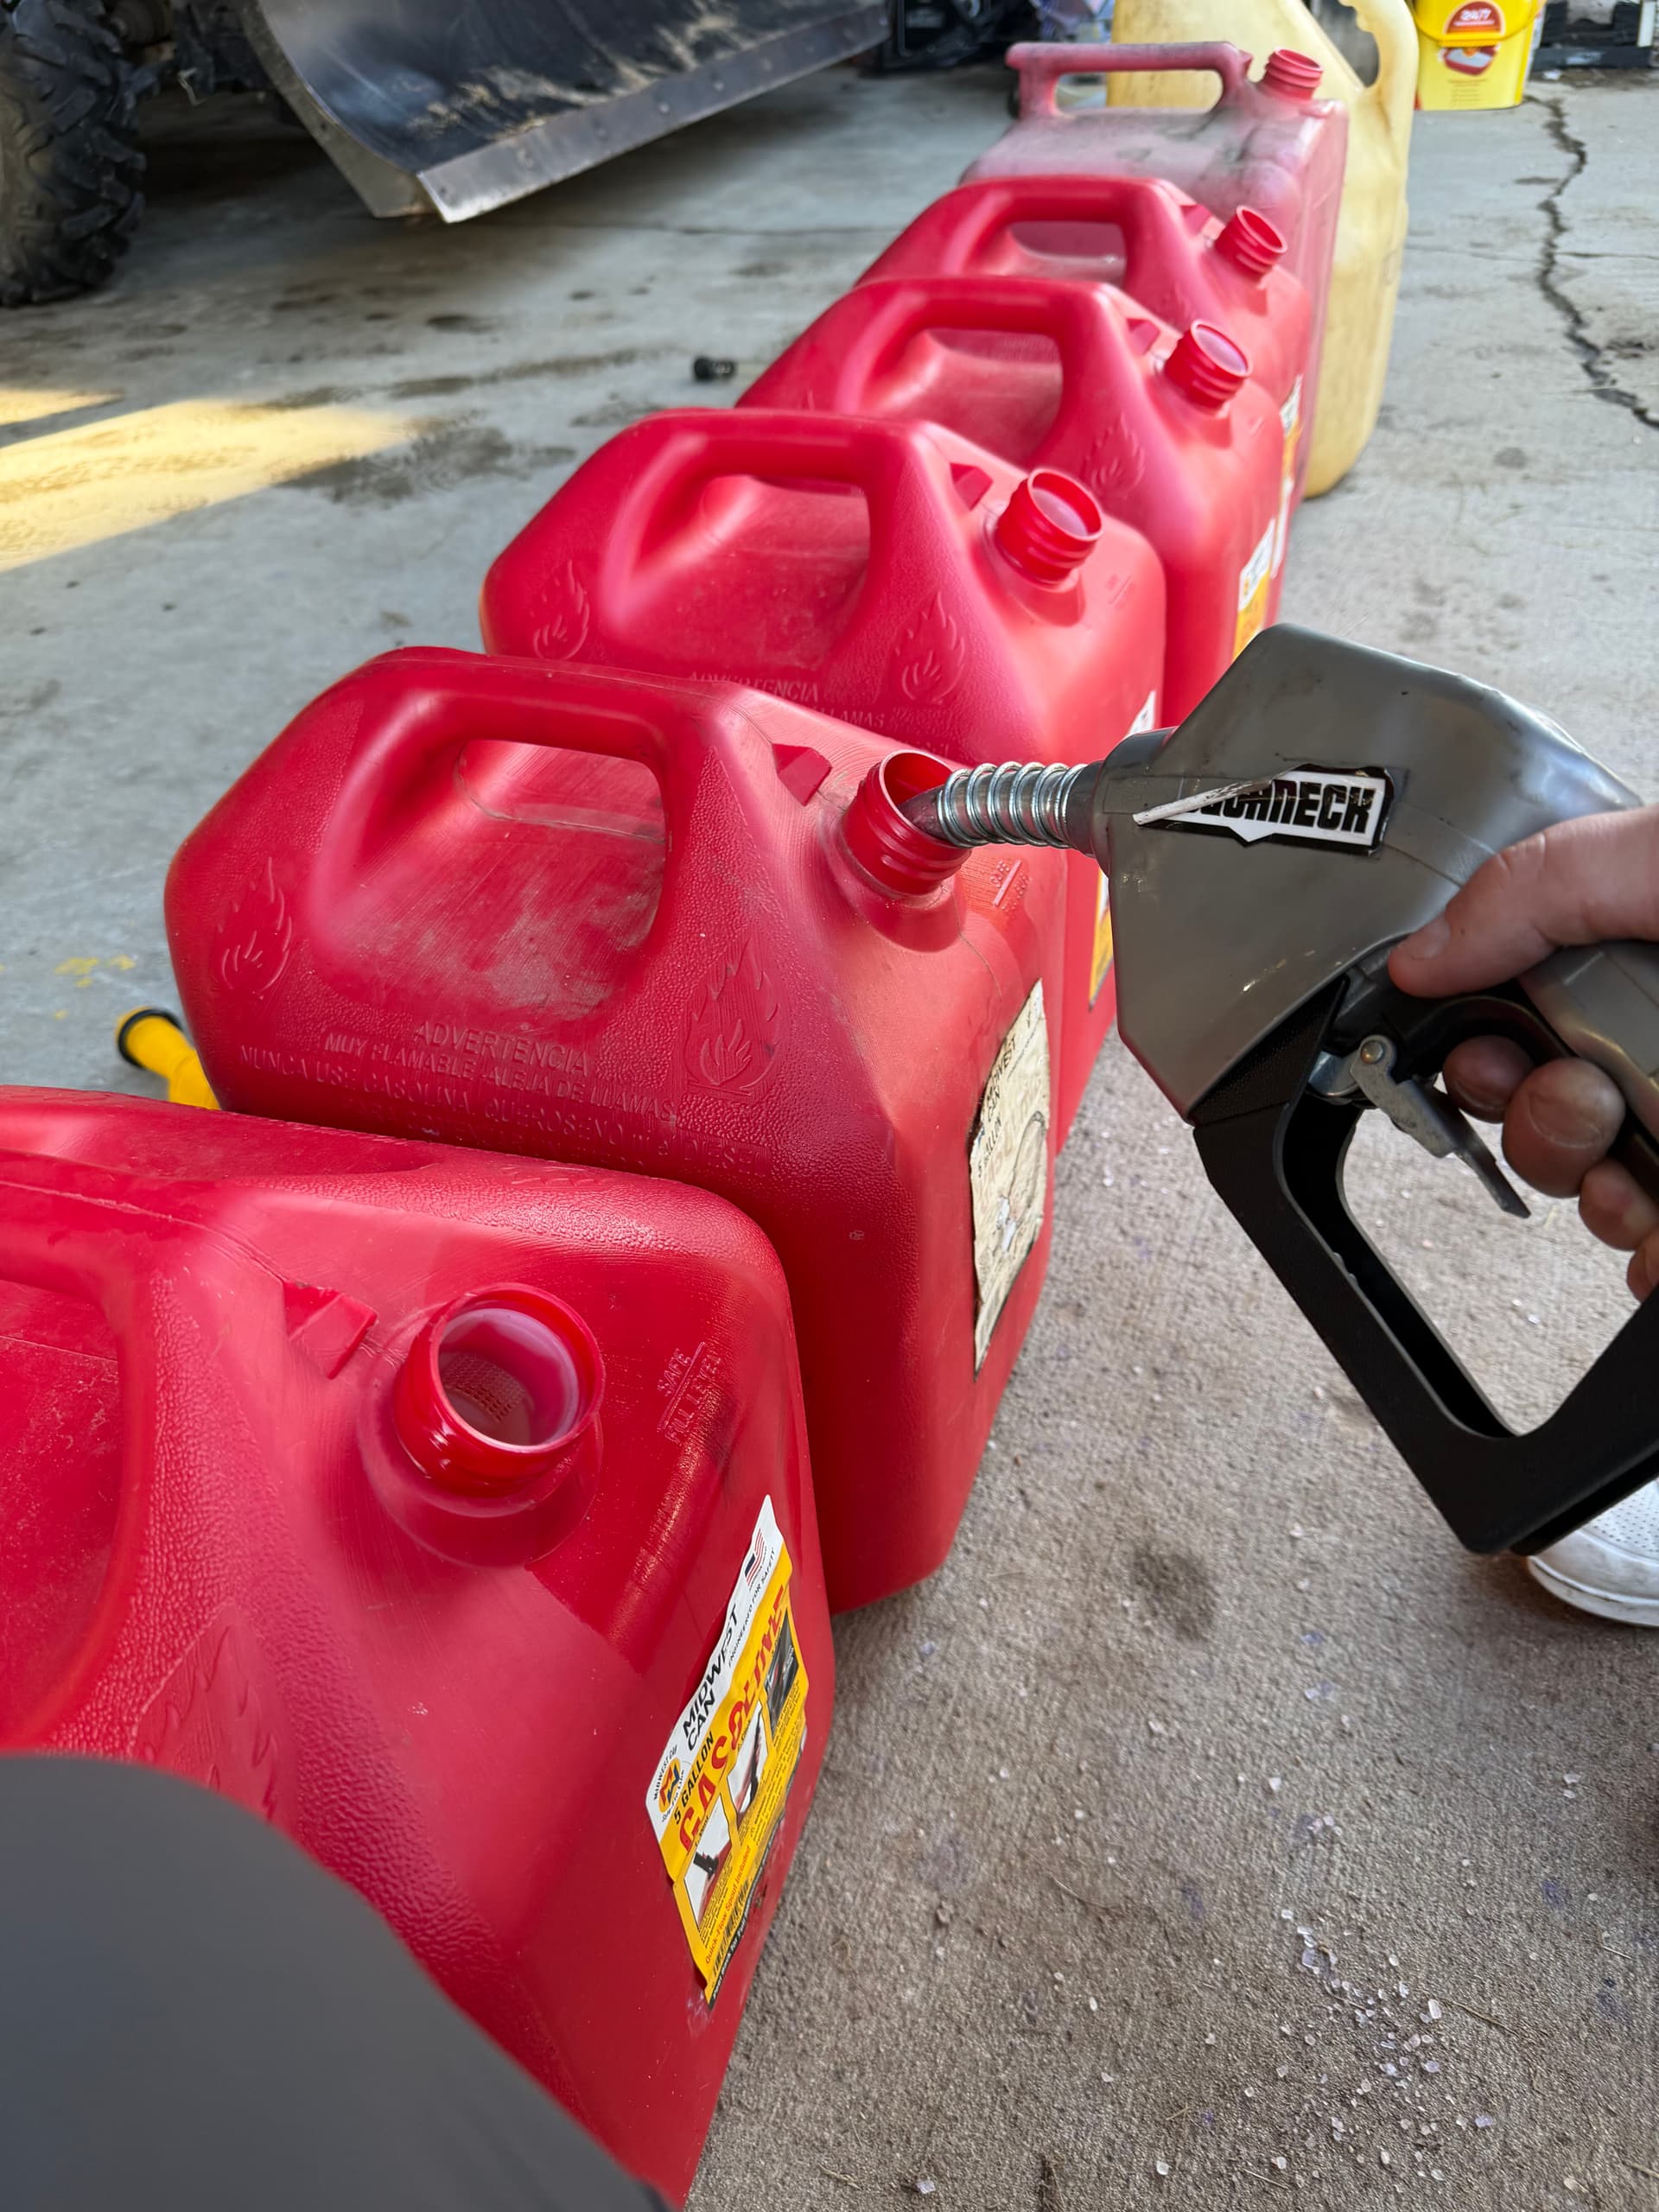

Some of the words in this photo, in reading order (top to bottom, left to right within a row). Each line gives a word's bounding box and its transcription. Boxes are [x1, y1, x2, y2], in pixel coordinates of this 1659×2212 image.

[324, 1031, 368, 1057] MUY
[556, 1082, 585, 1104] DE
[590, 1085, 675, 1122] LLAMAS
[413, 1020, 588, 1077] ADVERTENCIA
[683, 1603, 736, 1738] MIDWEST
[687, 1691, 715, 1751] CAN
[673, 1808, 682, 1825] 5
[681, 1731, 715, 1808] GALLON
